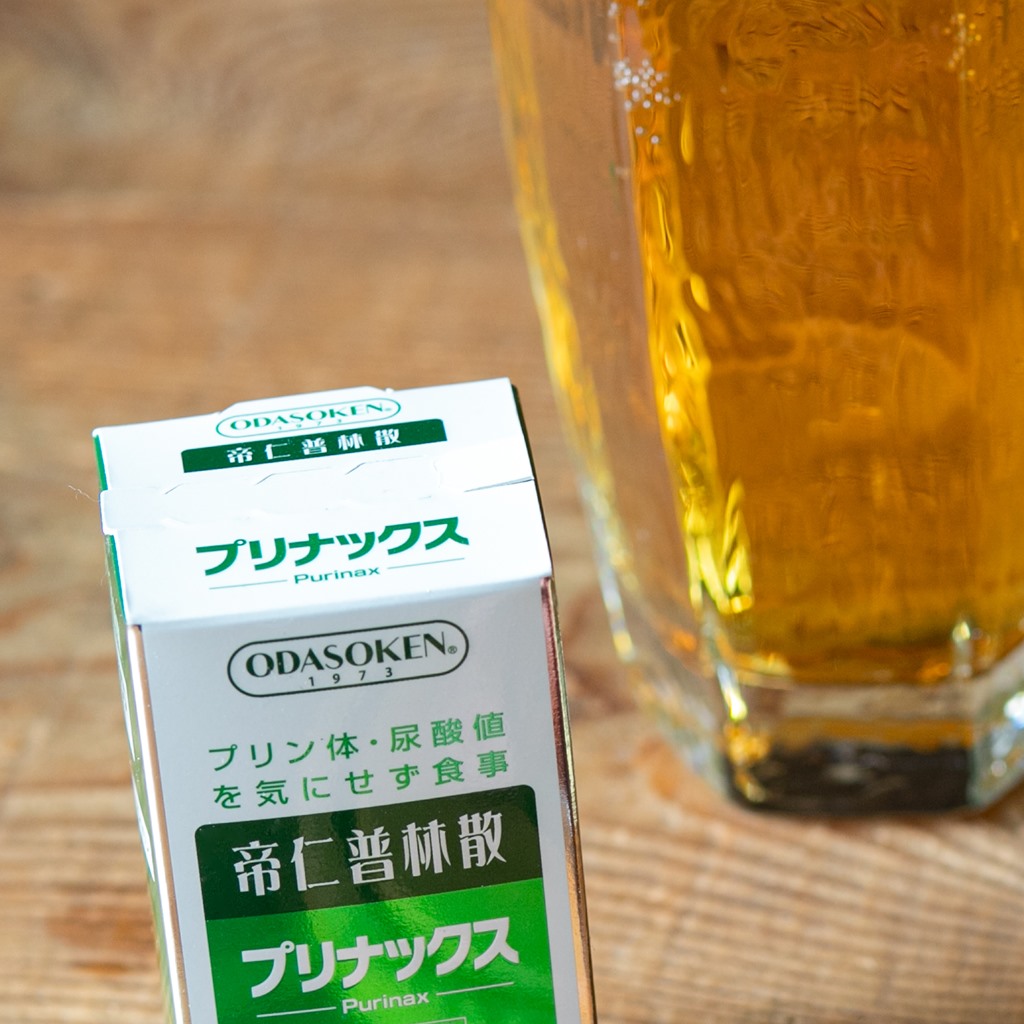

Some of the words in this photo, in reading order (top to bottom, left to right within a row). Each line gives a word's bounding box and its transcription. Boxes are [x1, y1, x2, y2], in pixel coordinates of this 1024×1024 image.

[230, 402, 385, 431] ODASOKEN
[227, 428, 402, 464] 帝仁普林散
[196, 516, 470, 576] プリナックス
[294, 566, 381, 585] Purinax
[246, 631, 447, 678] ODASOKEN
[308, 667, 394, 687] 1973
[208, 711, 508, 773] プリン体・尿酸値
[213, 750, 510, 810] を気にせず食事
[231, 809, 508, 897] 帝仁普林散
[241, 916, 520, 998] プリナックス
[342, 991, 430, 1015] Purinax
